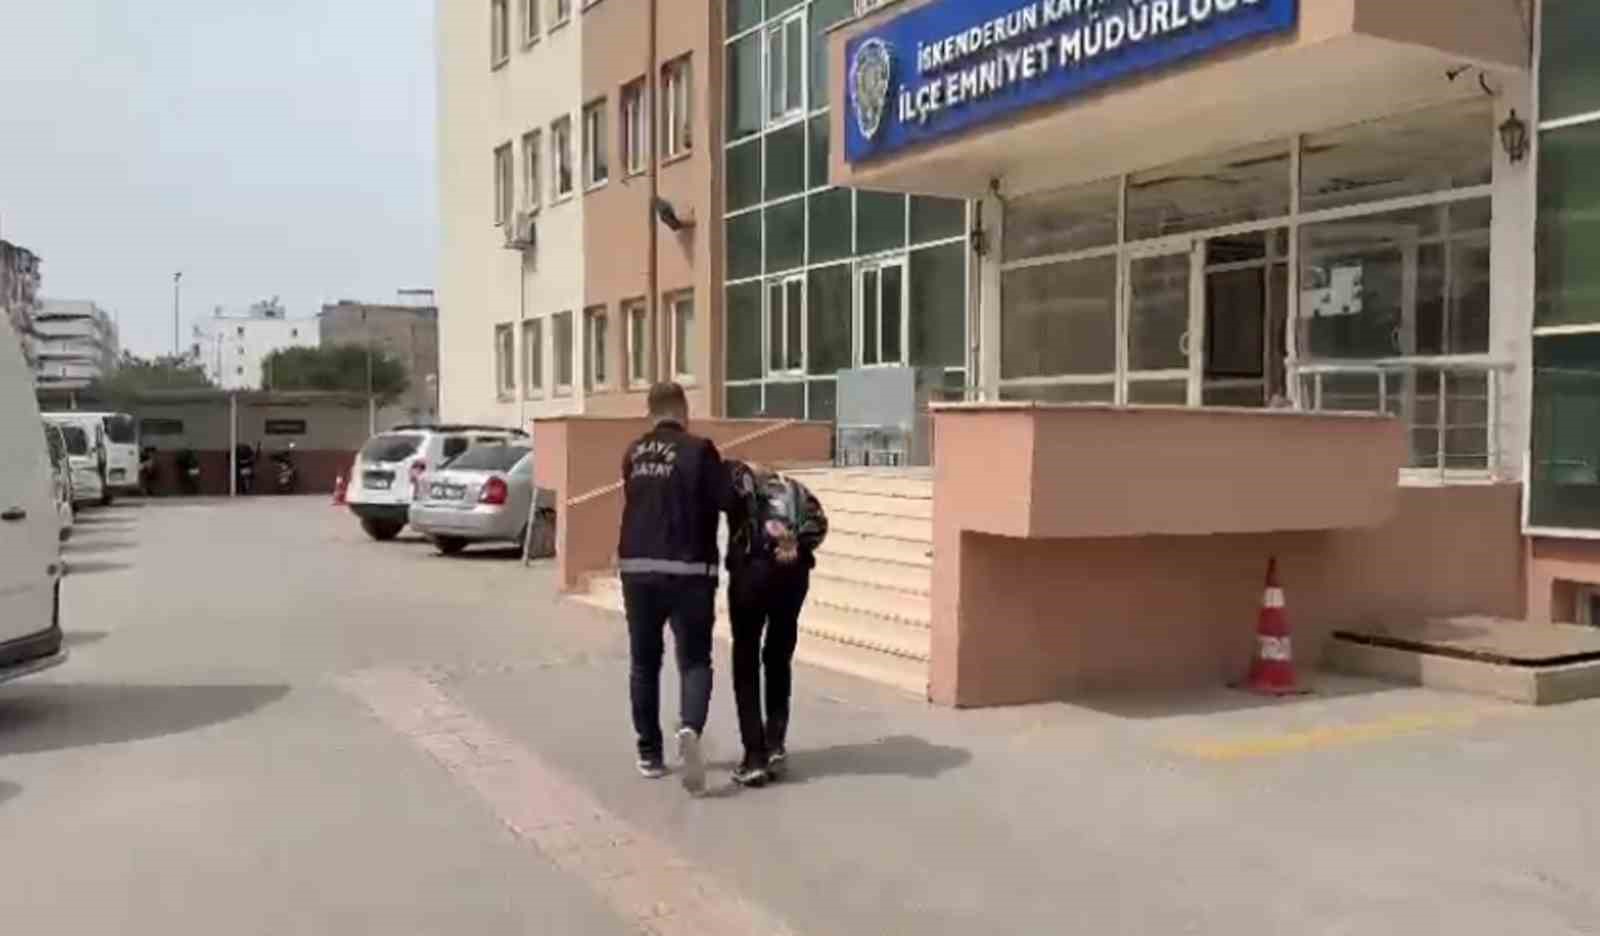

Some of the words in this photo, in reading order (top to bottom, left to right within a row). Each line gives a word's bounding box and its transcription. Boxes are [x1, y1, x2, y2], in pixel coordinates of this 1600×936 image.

[898, 79, 942, 125] İLÇE
[945, 38, 1054, 106] EMNİYET
[1059, 0, 1258, 67] MÜDÜRL
[916, 4, 1037, 75] İSKENDERUN
